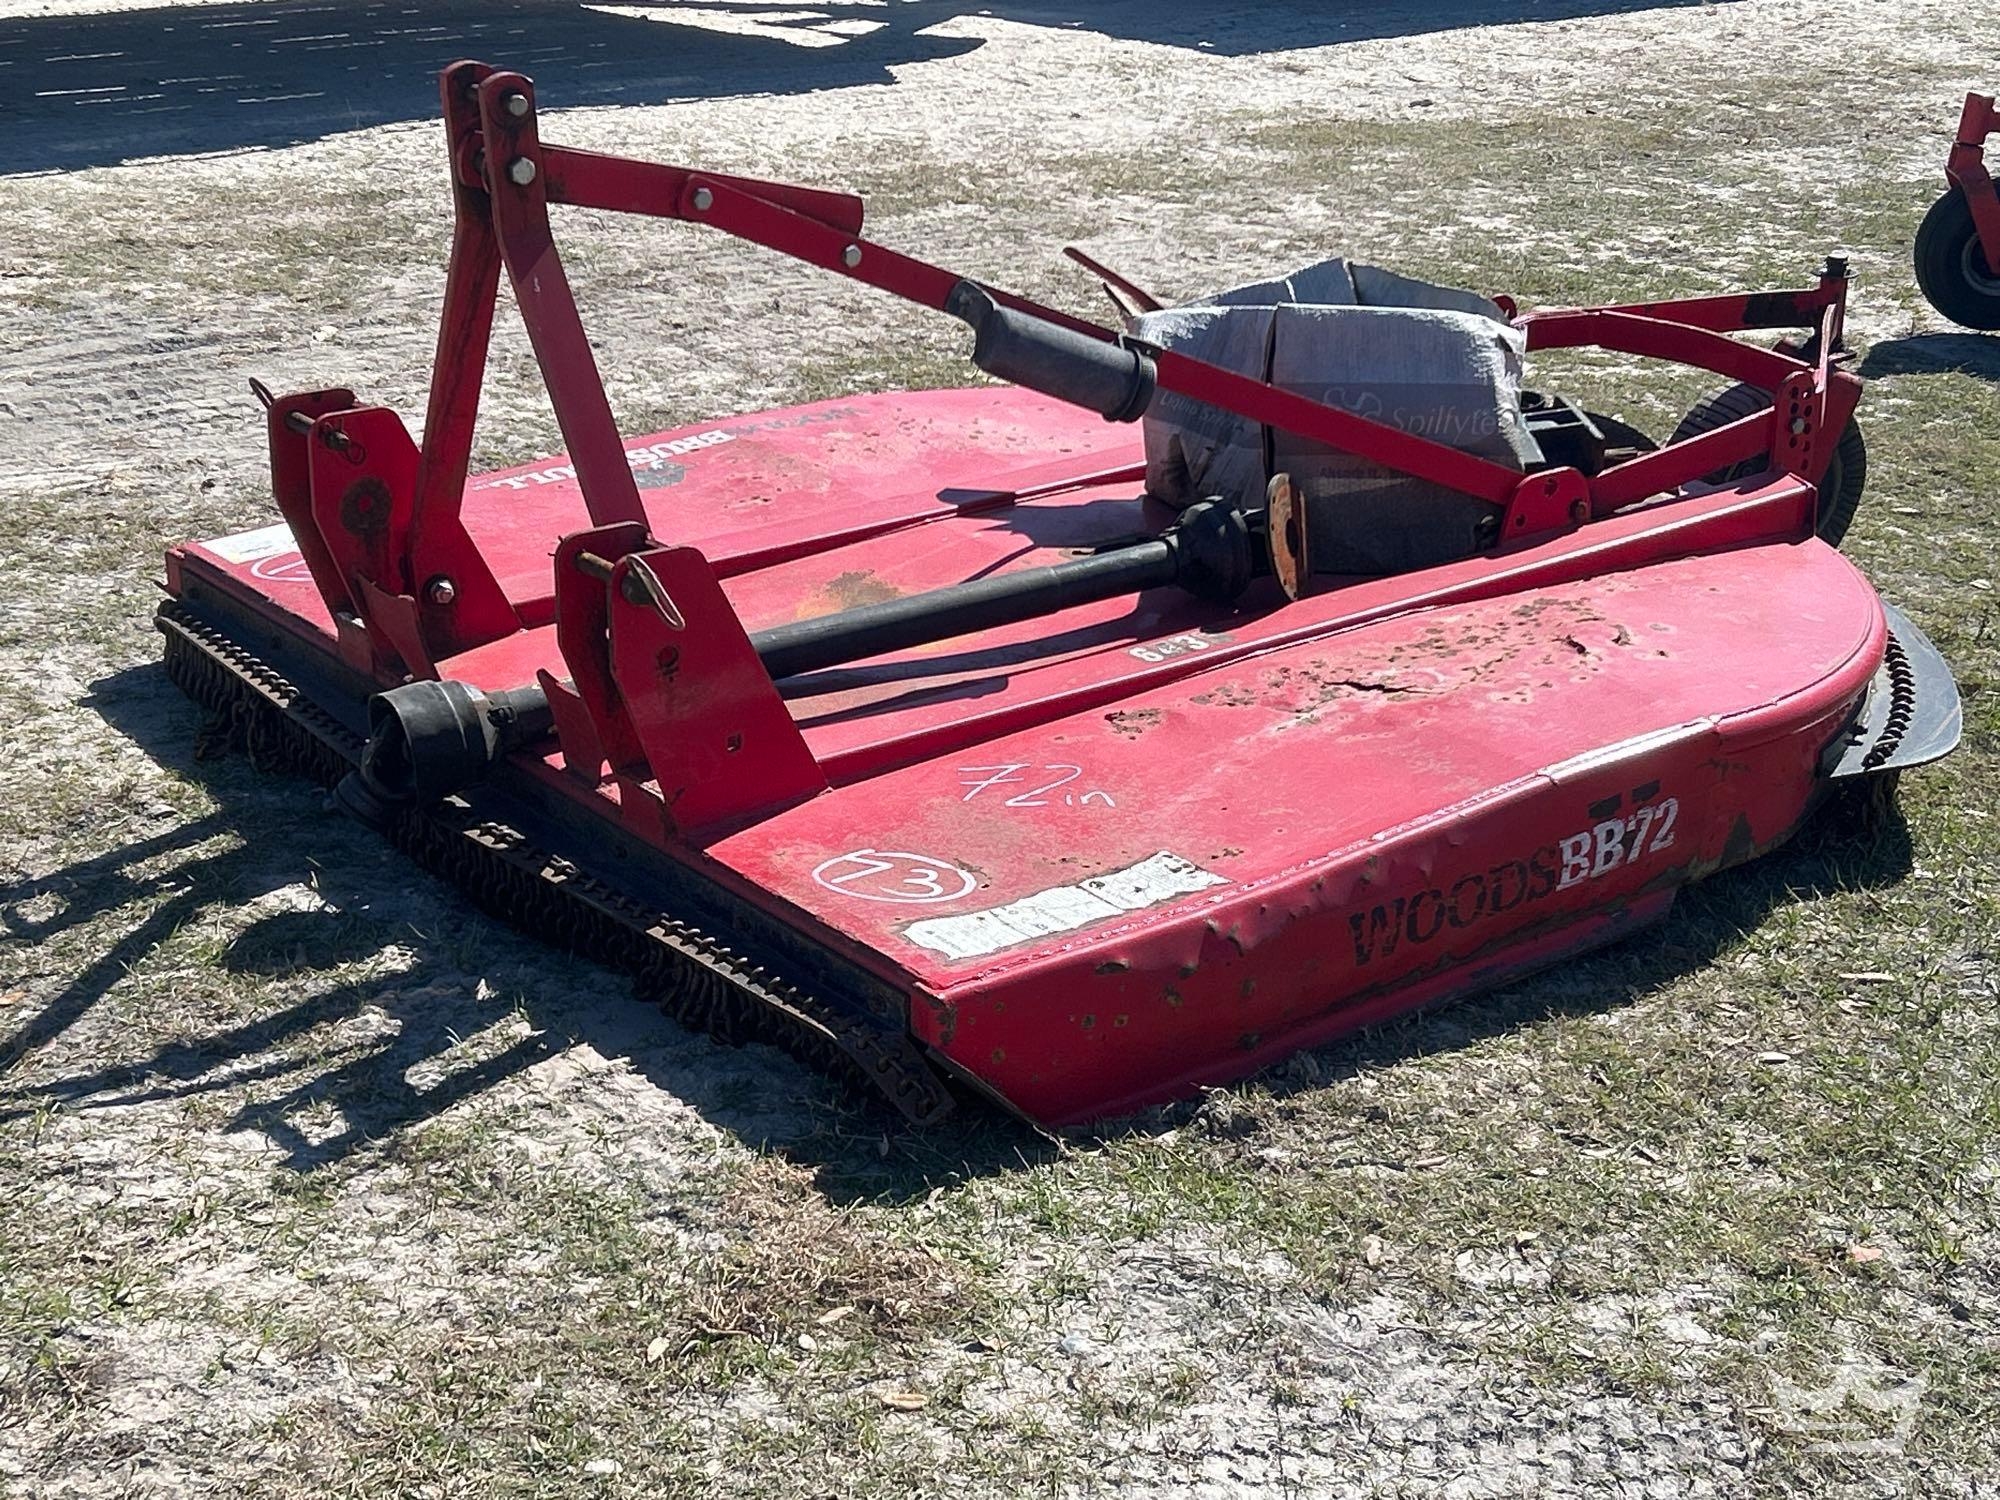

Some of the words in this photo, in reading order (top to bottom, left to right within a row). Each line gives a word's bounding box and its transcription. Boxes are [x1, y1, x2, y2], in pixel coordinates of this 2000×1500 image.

[1393, 405, 1497, 445] Spilfyte
[625, 429, 736, 467] BRUS
[488, 465, 577, 491] ULL
[1349, 847, 1556, 967] WOODS
[1555, 797, 1679, 892] BB72
